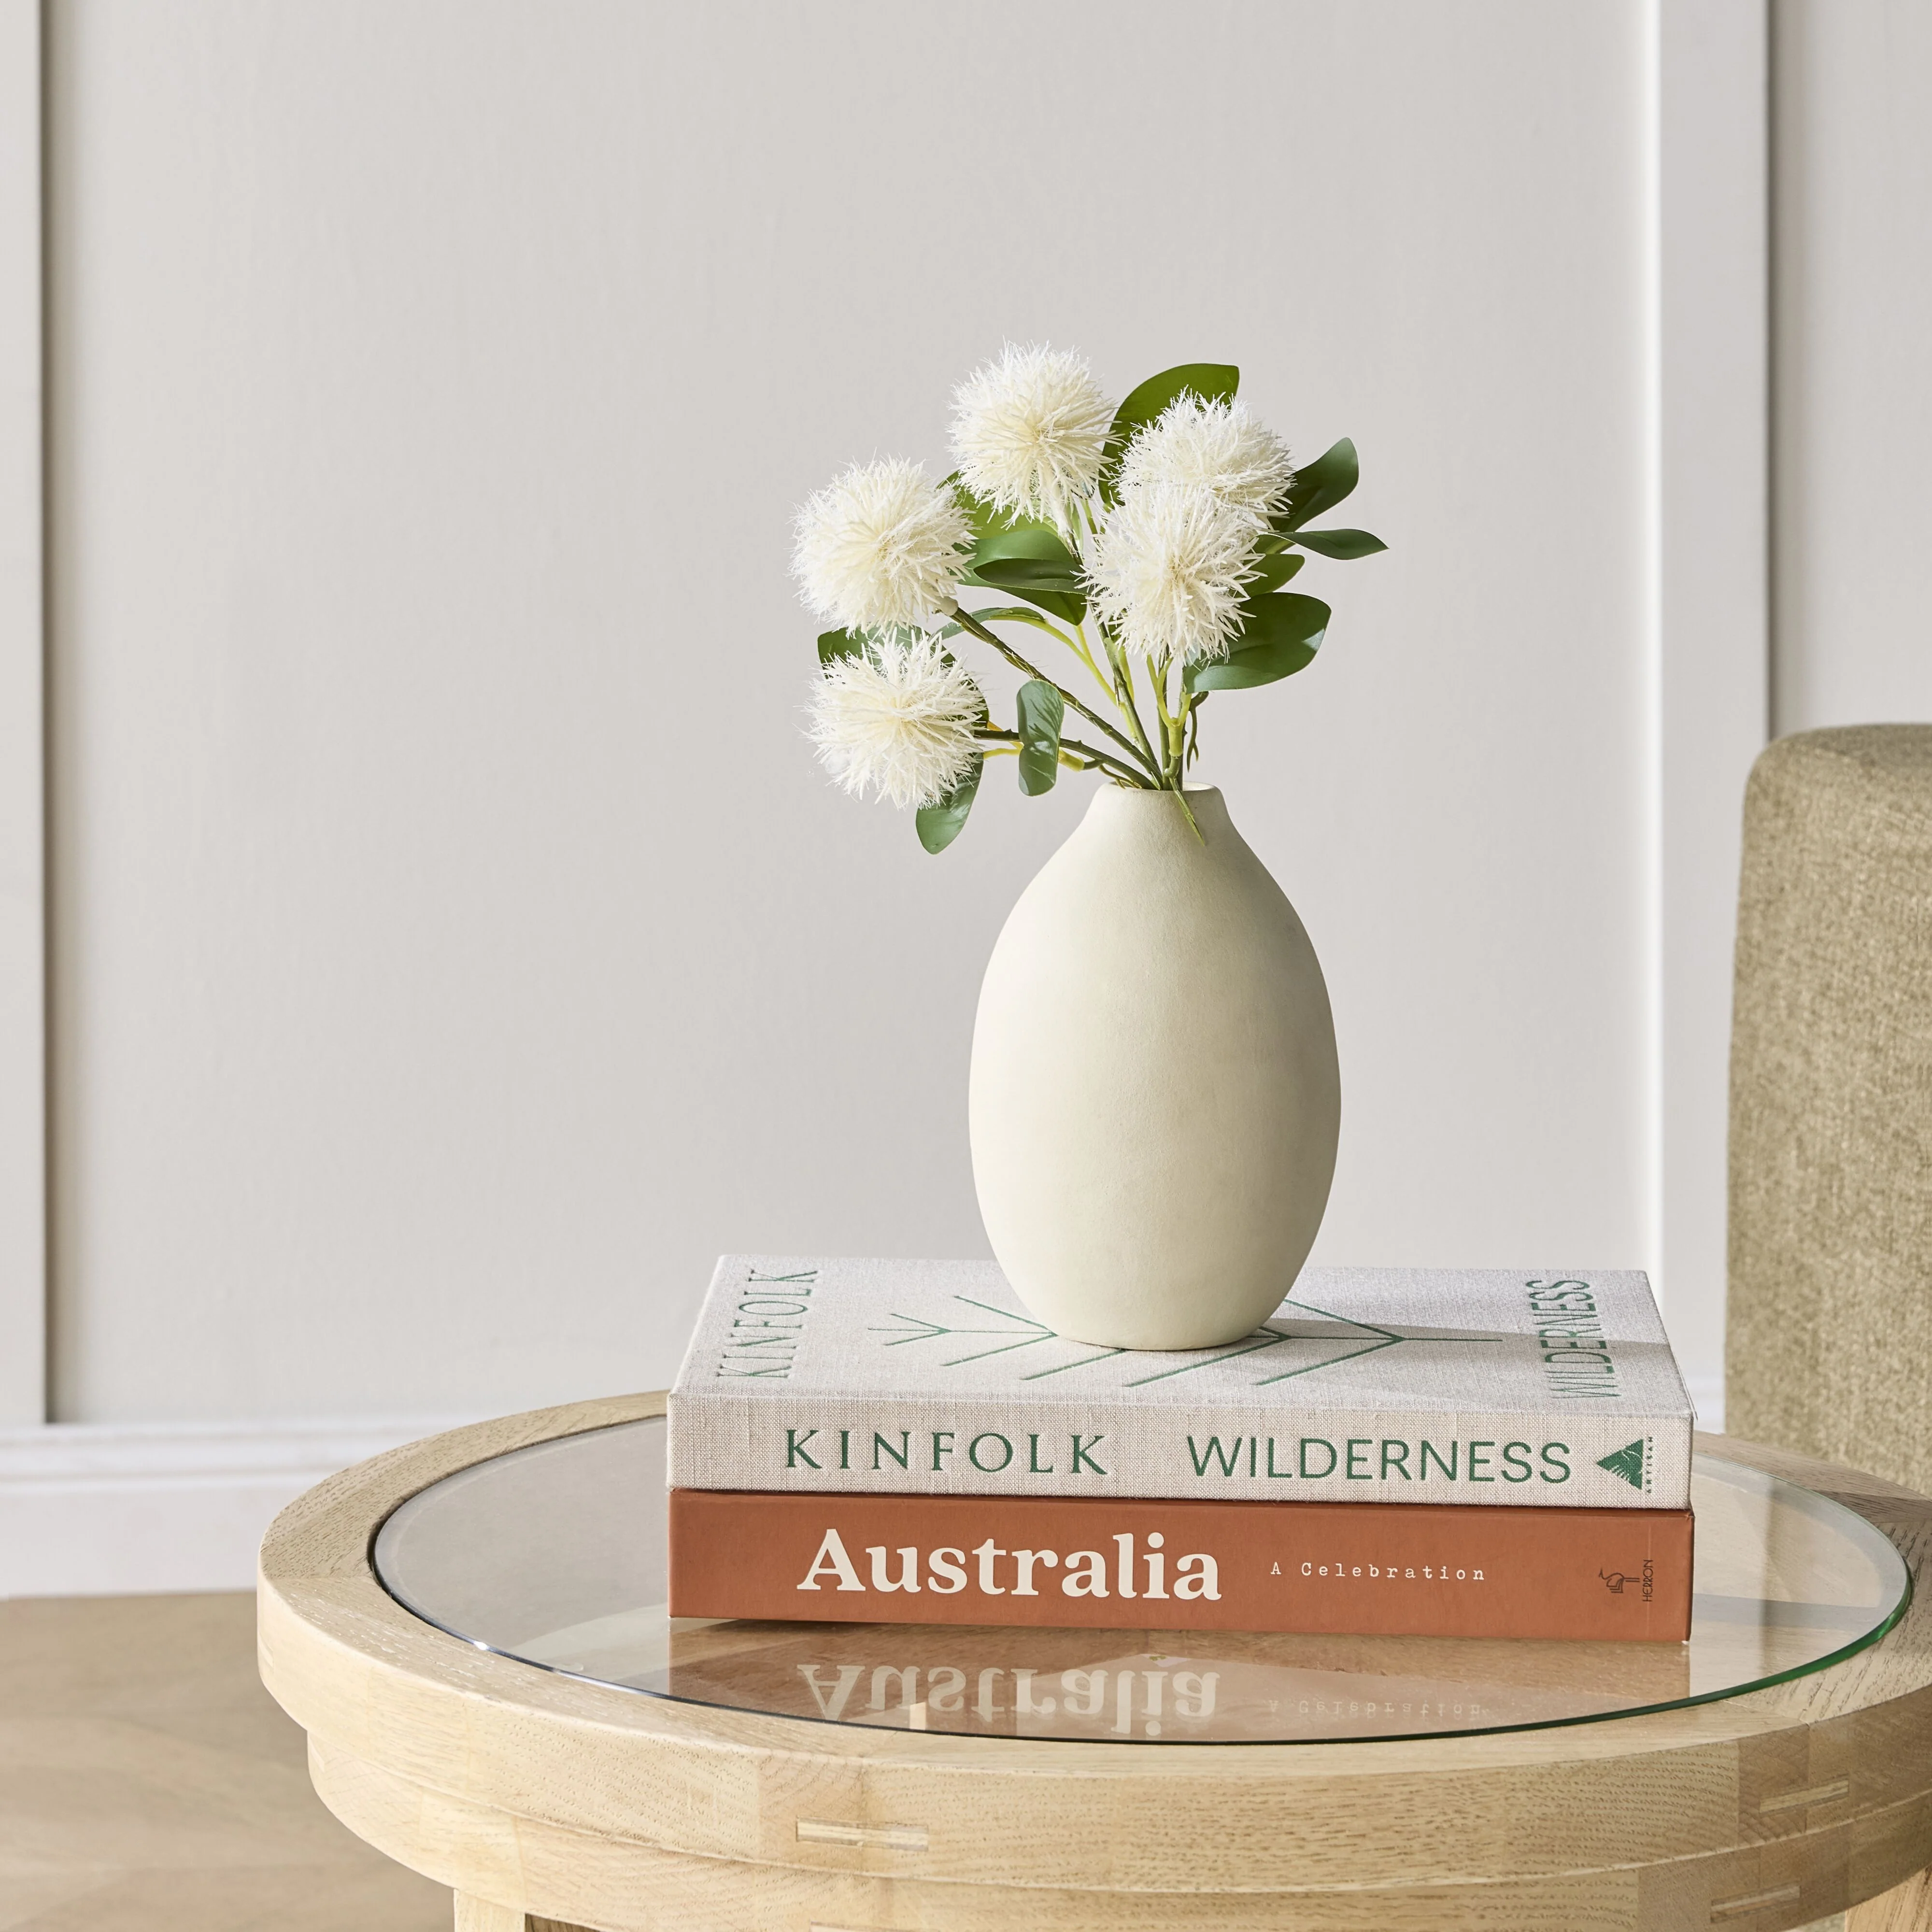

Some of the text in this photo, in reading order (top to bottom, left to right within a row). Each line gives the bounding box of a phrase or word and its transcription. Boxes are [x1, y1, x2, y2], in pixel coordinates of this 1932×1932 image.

[716, 1269, 818, 1378] KINFOLK
[1526, 1280, 1621, 1398] WILDERNESS
[786, 1429, 1571, 1484] KINFOLK WILDERNESS
[796, 1528, 1485, 1600] Australia A Celebration
[1642, 1560, 1654, 1602] HERRON
